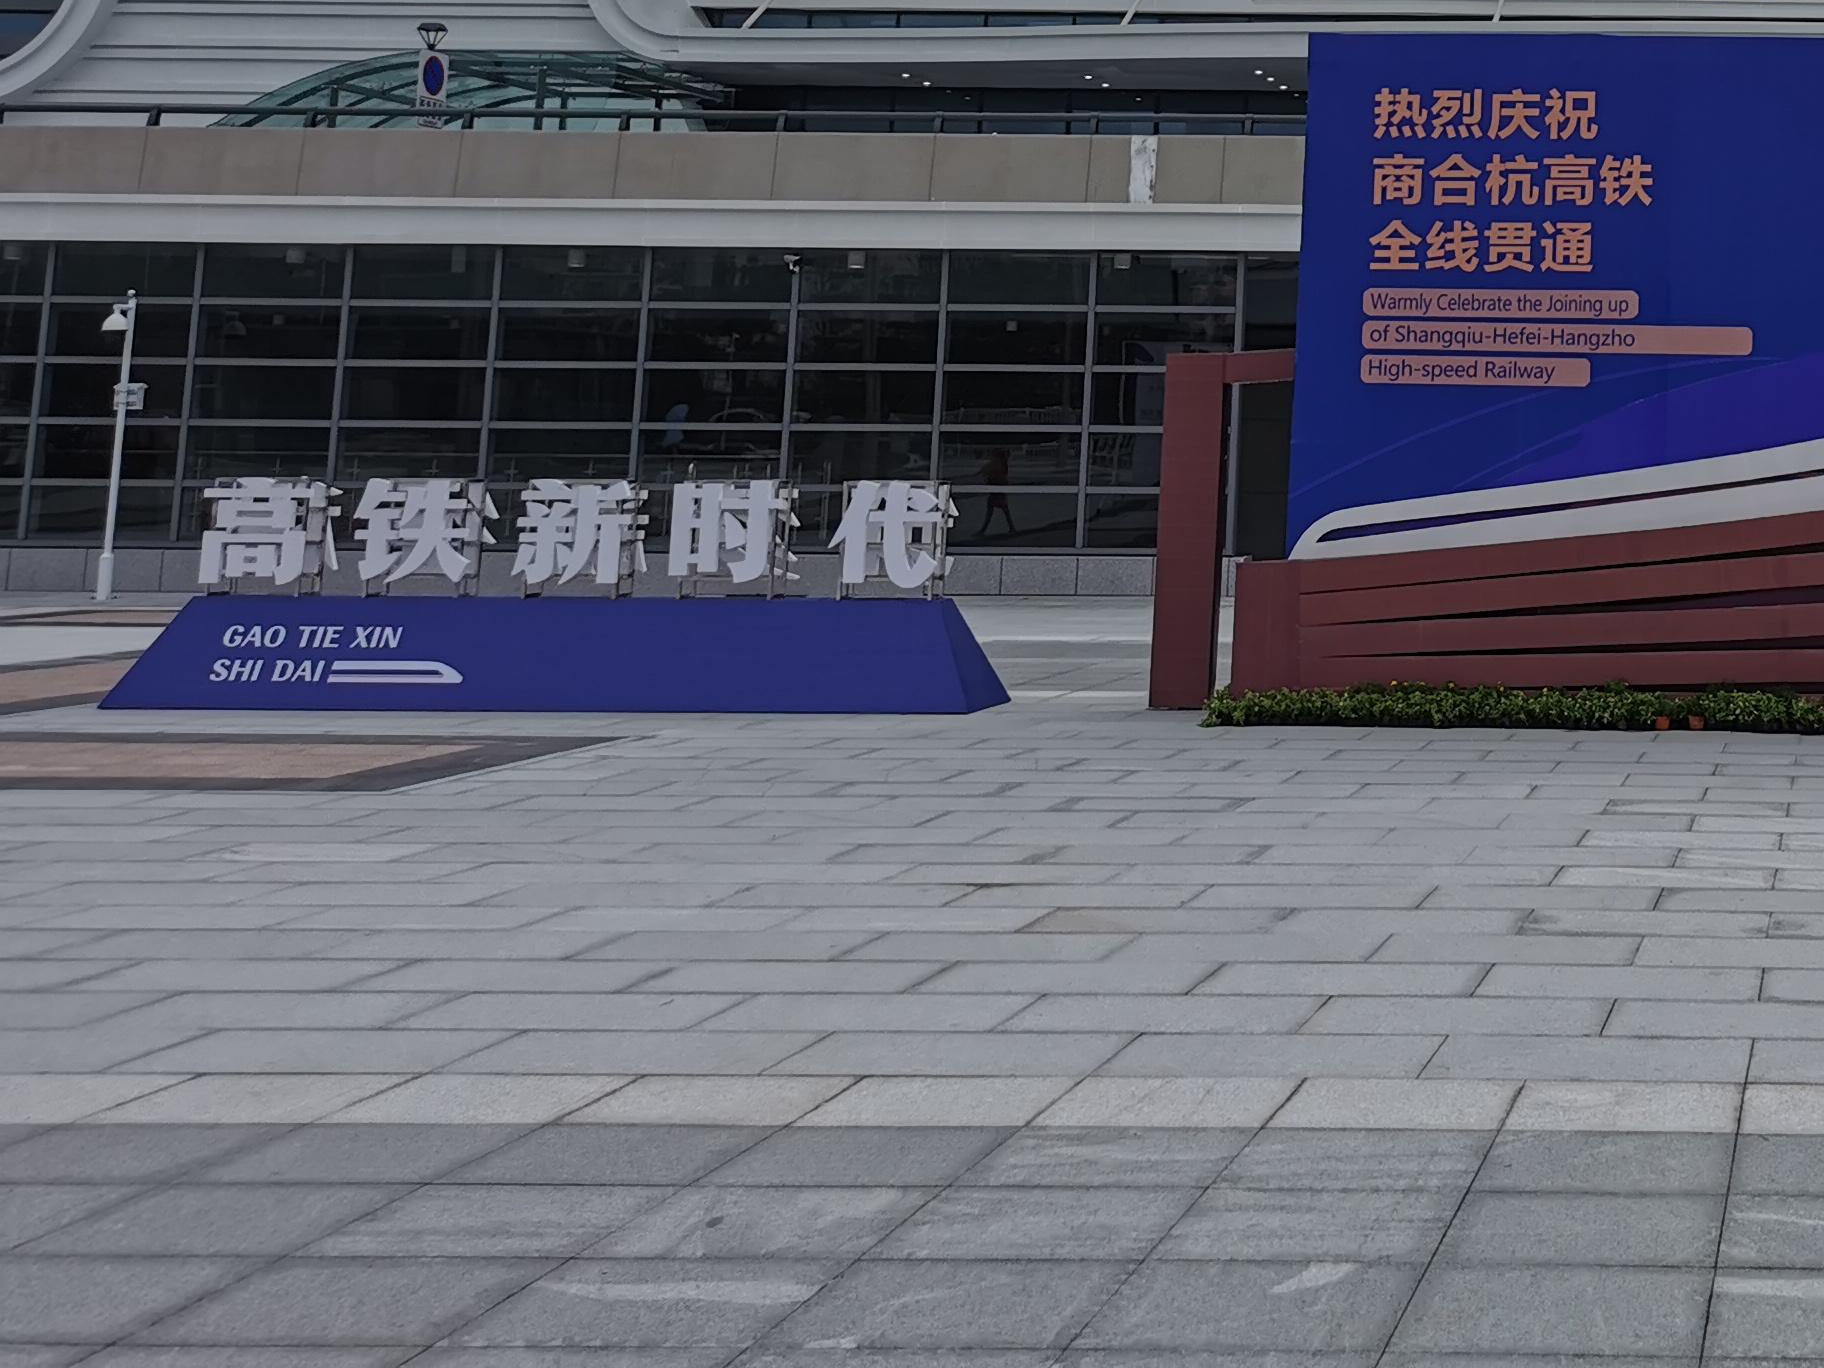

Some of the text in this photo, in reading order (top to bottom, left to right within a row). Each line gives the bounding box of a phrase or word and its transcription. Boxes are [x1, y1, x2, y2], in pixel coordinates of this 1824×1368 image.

[1373, 87, 1600, 141] 热烈庆祝
[1372, 153, 1655, 208] 商合杭高铁
[1368, 219, 1595, 273] 全线贯通
[1369, 291, 1630, 318] Warmly Celebrate the Joining up
[1369, 324, 1636, 351] of Shangqiu-Hefei-Hangzho
[1367, 358, 1556, 383] High-speed Railway
[198, 476, 950, 589] 高铁新时代
[222, 624, 404, 649] GAO TIE XIN
[209, 658, 326, 682] SHI DAI
